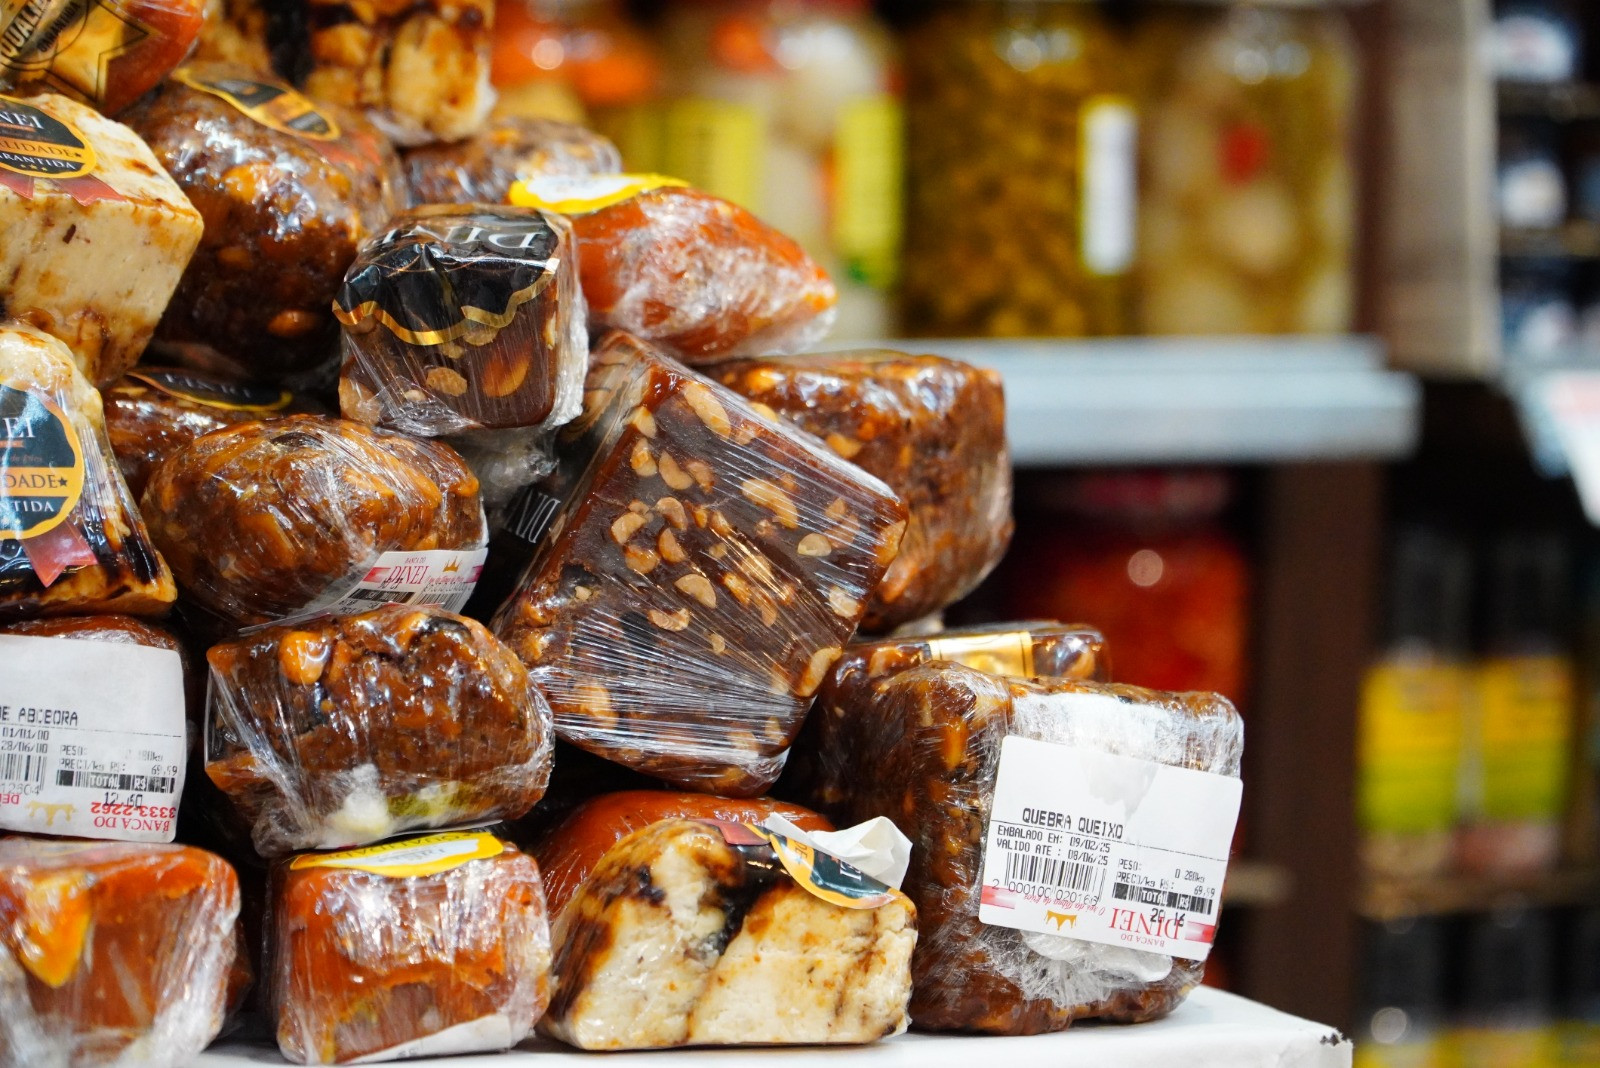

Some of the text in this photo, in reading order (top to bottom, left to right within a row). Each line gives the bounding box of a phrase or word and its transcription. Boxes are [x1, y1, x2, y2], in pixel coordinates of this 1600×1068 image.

[0, 0, 52, 58] QUALI
[0, 139, 74, 158] LIDADE
[0, 152, 77, 171] RANTIDA
[385, 565, 430, 585] DINEI
[89, 774, 120, 790] TOTAL
[91, 801, 177, 819] 3333-2262
[93, 815, 170, 832] BANCA DO
[1022, 808, 1124, 840] QUEBRA QUEIXO
[997, 824, 1043, 841] EMBALADO
[1069, 836, 1111, 853] 09/02/25
[996, 838, 1031, 853] VALIDO
[1067, 849, 1109, 866] 08/06/25
[1141, 888, 1169, 907] TOTAL
[1109, 907, 1180, 940] DINEI
[1120, 933, 1165, 948] BANCA DO
